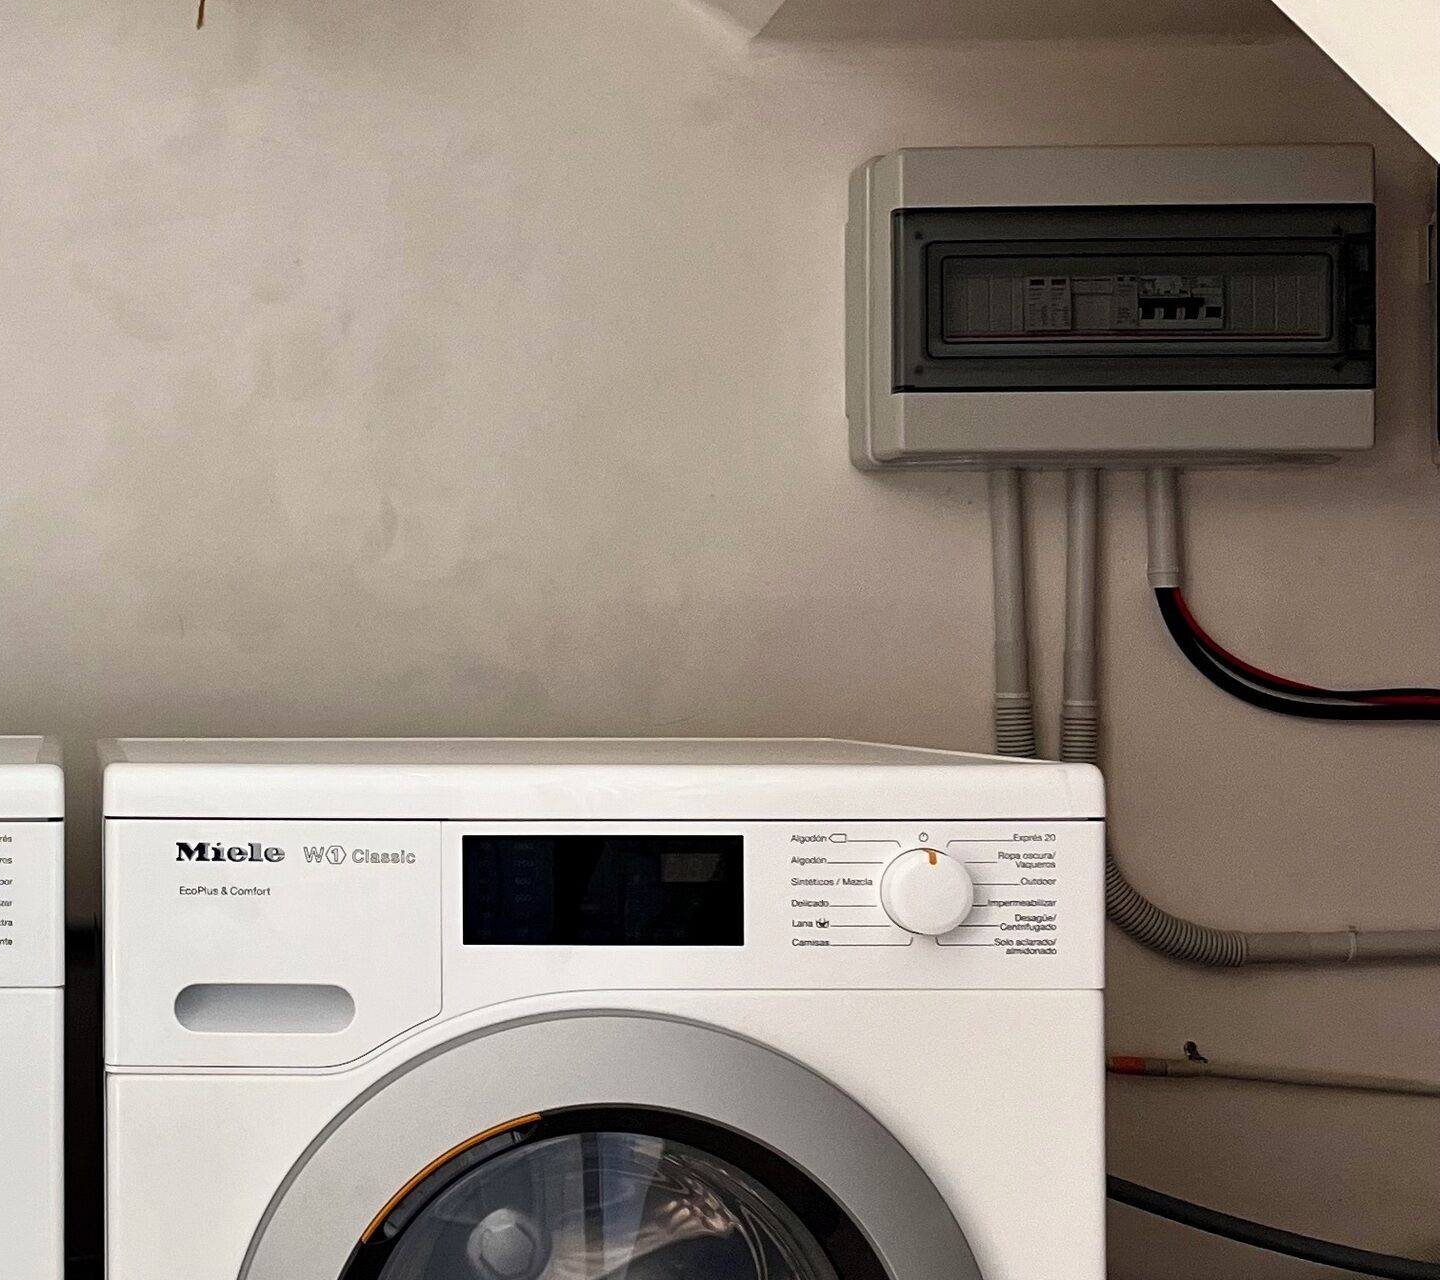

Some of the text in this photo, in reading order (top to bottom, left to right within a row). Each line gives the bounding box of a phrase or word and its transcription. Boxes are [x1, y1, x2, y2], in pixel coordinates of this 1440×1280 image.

[791, 834, 828, 844] Algodón
[1013, 833, 1057, 844] Exprés 20
[175, 841, 286, 863] Miele
[352, 847, 417, 865] Classic
[998, 852, 1020, 862] Ropa
[791, 856, 828, 866] Algodón
[1015, 860, 1056, 870] Vaqueros
[791, 877, 835, 887] Sintéticos
[843, 877, 873, 887] Mezcla
[1020, 877, 1057, 887] Outdoor
[179, 886, 219, 896] EcoPlus
[230, 886, 271, 897] Comfort
[791, 898, 830, 908] Delicado
[792, 919, 814, 928] Lana
[792, 938, 830, 948] Camisas
